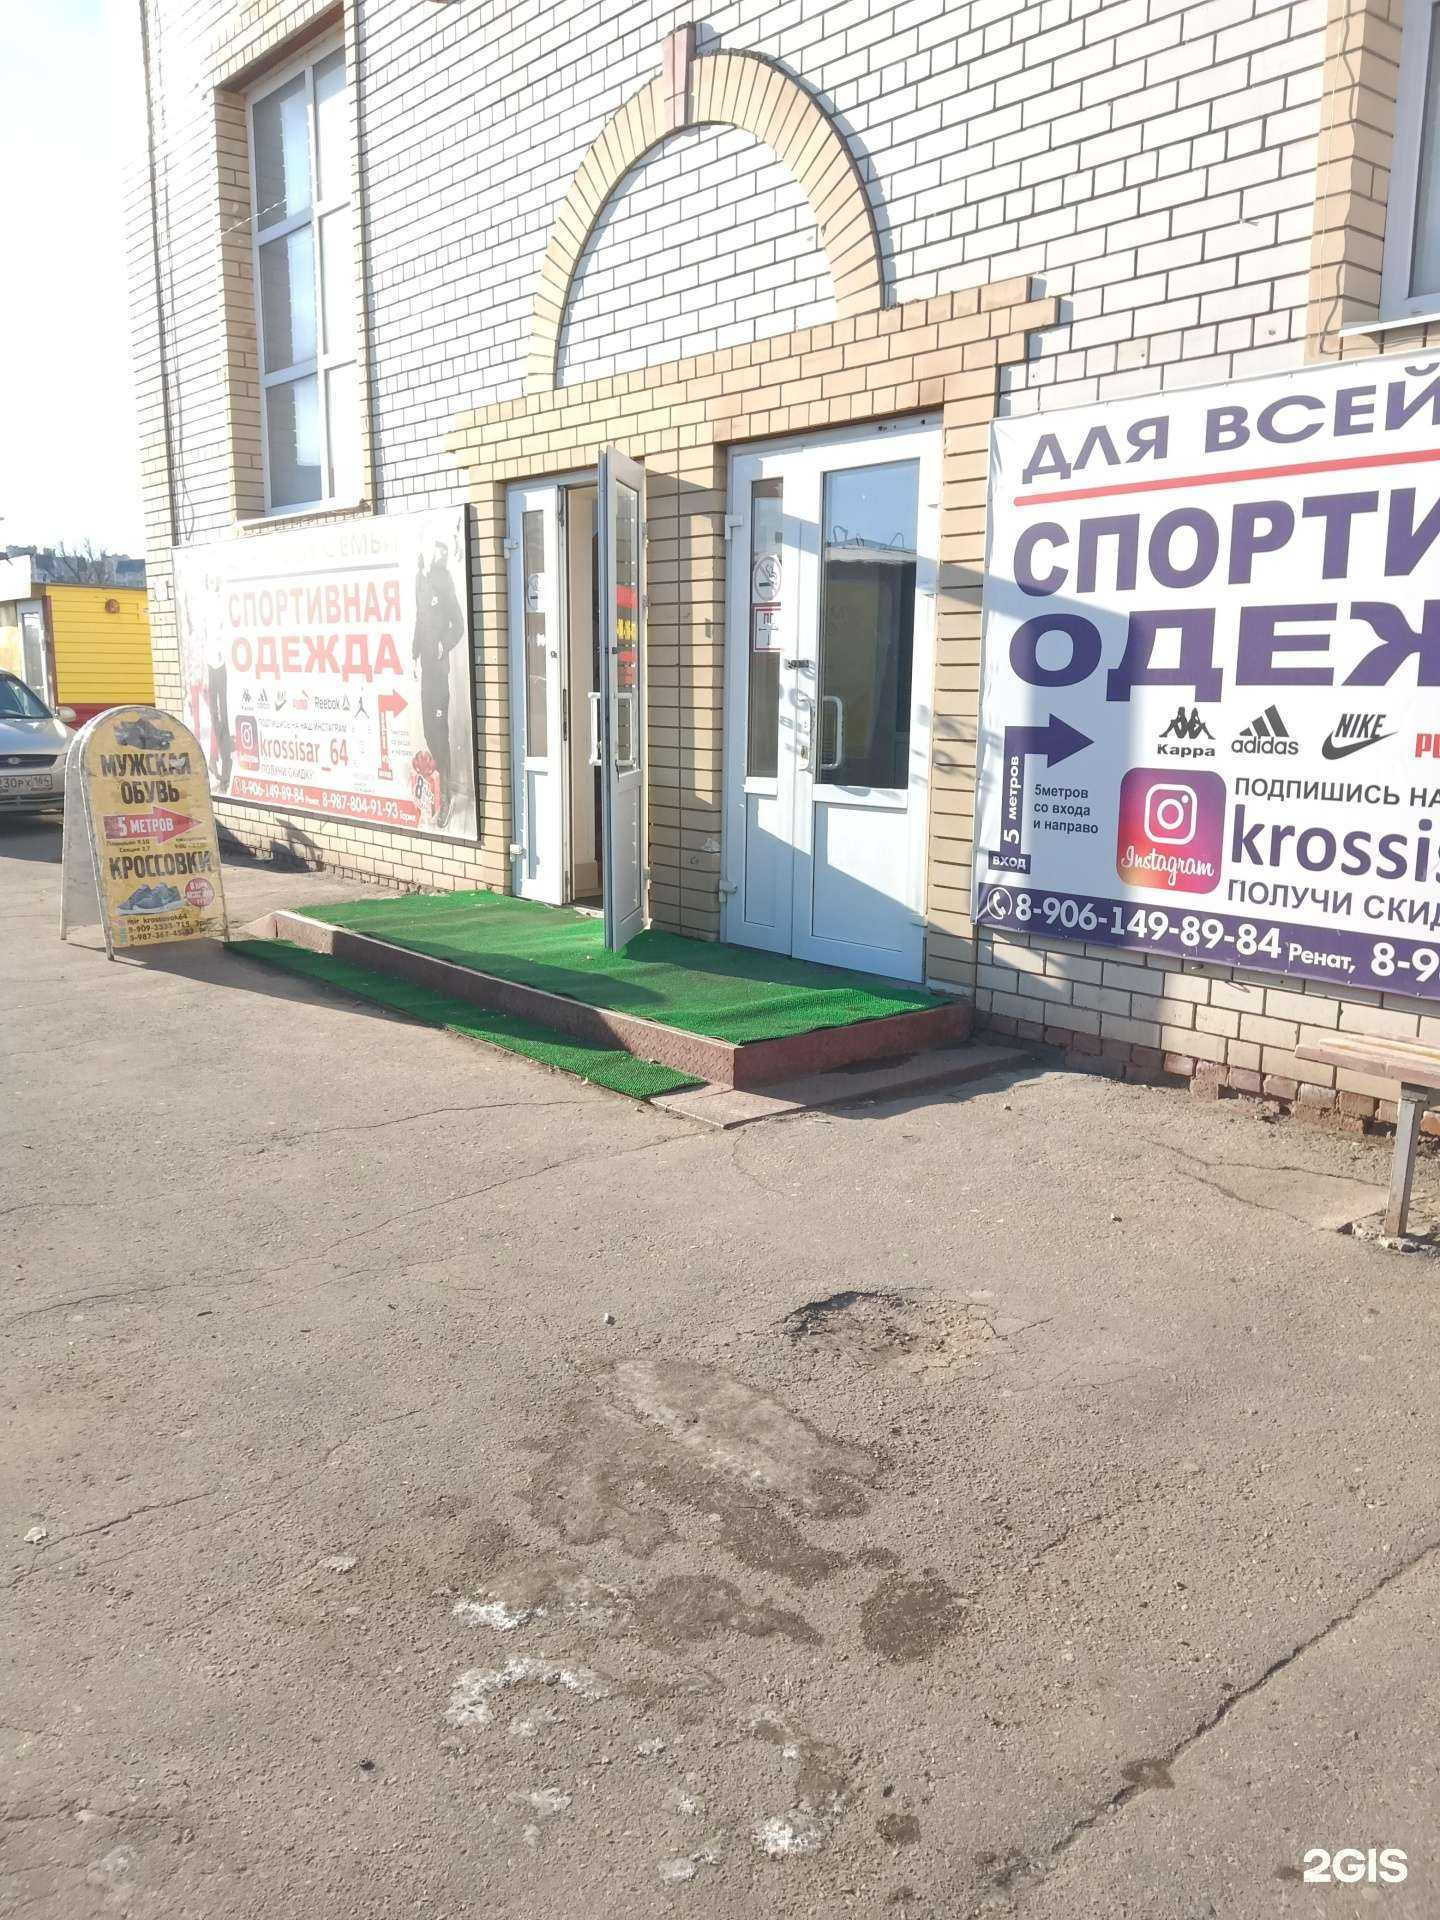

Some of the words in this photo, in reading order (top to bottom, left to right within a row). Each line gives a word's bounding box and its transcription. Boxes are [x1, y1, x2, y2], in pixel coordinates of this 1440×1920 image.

[1021, 415, 1170, 485] ДЛЯ
[228, 579, 401, 628] СПОРТИВНАЯ
[231, 633, 404, 683] ОДЕЖДА
[1334, 712, 1387, 739] NIKE
[1156, 743, 1216, 759] Kappa
[1231, 735, 1299, 755] adidas
[100, 752, 192, 777] МУЖСКАЯ
[120, 780, 181, 804] ОБУВЬ
[1008, 755, 1022, 820] метров
[1034, 784, 1089, 800] 5метров
[1235, 777, 1401, 805] ПОДПИШИСЬ
[322, 791, 399, 818] 8-987-804-91-93
[1034, 803, 1049, 813] со
[1053, 804, 1091, 817] входа
[117, 816, 128, 836] 5
[129, 817, 174, 834] МЕТРОВ
[1003, 829, 1020, 844] 5
[1033, 820, 1041, 829] и
[1044, 820, 1099, 834] направо
[1231, 803, 1440, 883] krossi
[108, 851, 212, 880] КРОССОВКИ
[1121, 845, 1215, 886] Instagram
[1227, 879, 1353, 916] ПОЛУЧИ
[1015, 893, 1283, 960] 8-906-149-89-84
[1287, 942, 1357, 974] Ренат,
[1370, 942, 1440, 983] 8-9
